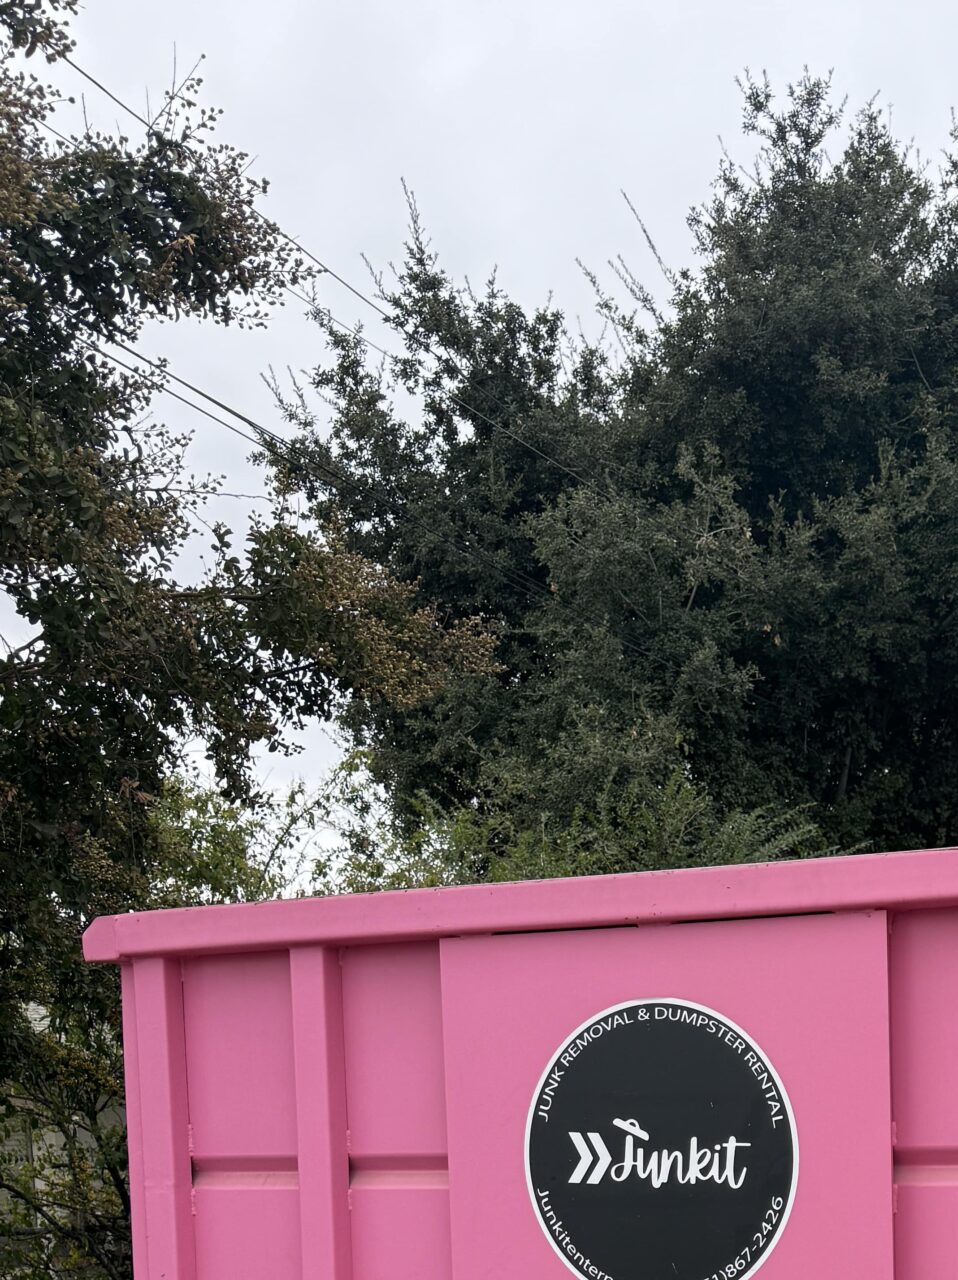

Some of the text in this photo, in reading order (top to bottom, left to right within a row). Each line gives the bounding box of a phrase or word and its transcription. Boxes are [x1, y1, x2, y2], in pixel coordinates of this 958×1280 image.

[538, 1006, 784, 1129] JUNK REMOVAL & DUMPSTER RENTAL
[611, 1118, 751, 1189] Junkit
